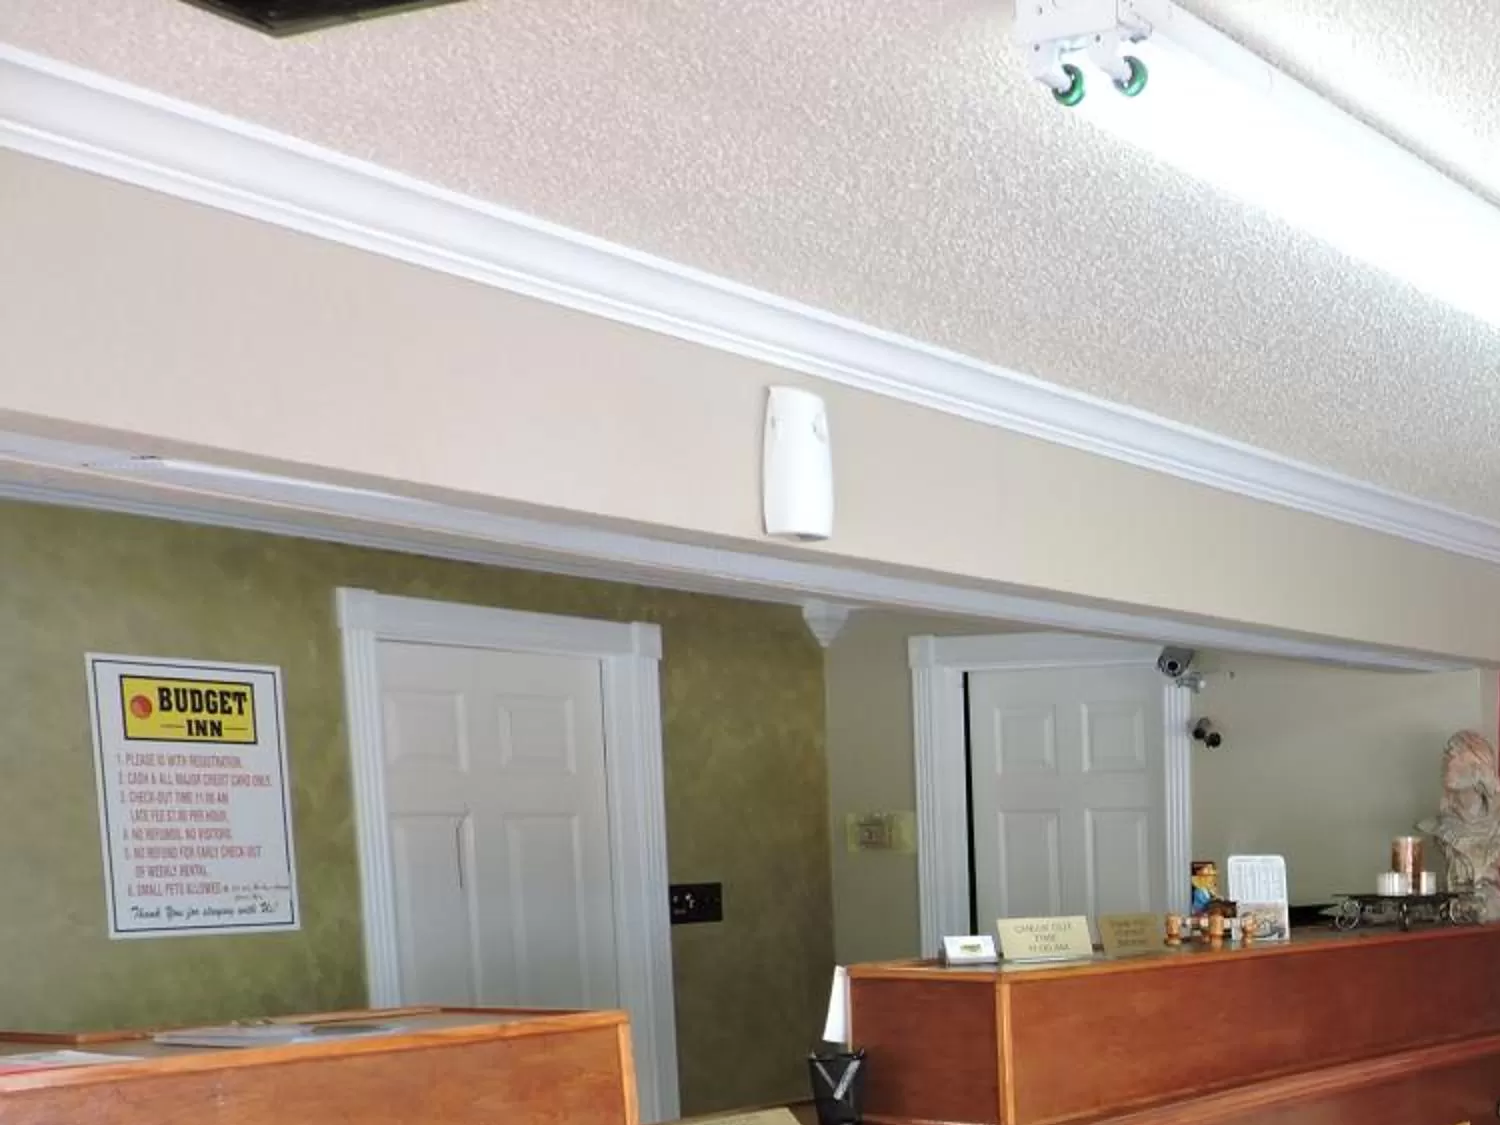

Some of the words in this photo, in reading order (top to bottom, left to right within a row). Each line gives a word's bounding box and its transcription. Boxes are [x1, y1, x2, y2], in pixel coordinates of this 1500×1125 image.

[157, 687, 247, 715] BUDGET
[186, 719, 223, 737] INN
[127, 771, 149, 785] CASH
[159, 771, 174, 785] ALL
[175, 772, 201, 786] MAJOR
[203, 773, 229, 787] CREDIT
[175, 791, 193, 804] TIME
[132, 828, 144, 840] NO
[185, 828, 197, 840] NO
[180, 847, 195, 859] FOR
[137, 883, 163, 897] SMALL
[165, 883, 185, 896] PETS
[187, 882, 221, 895] ALLOWED
[131, 905, 161, 920] Thank
[165, 905, 184, 922] You
